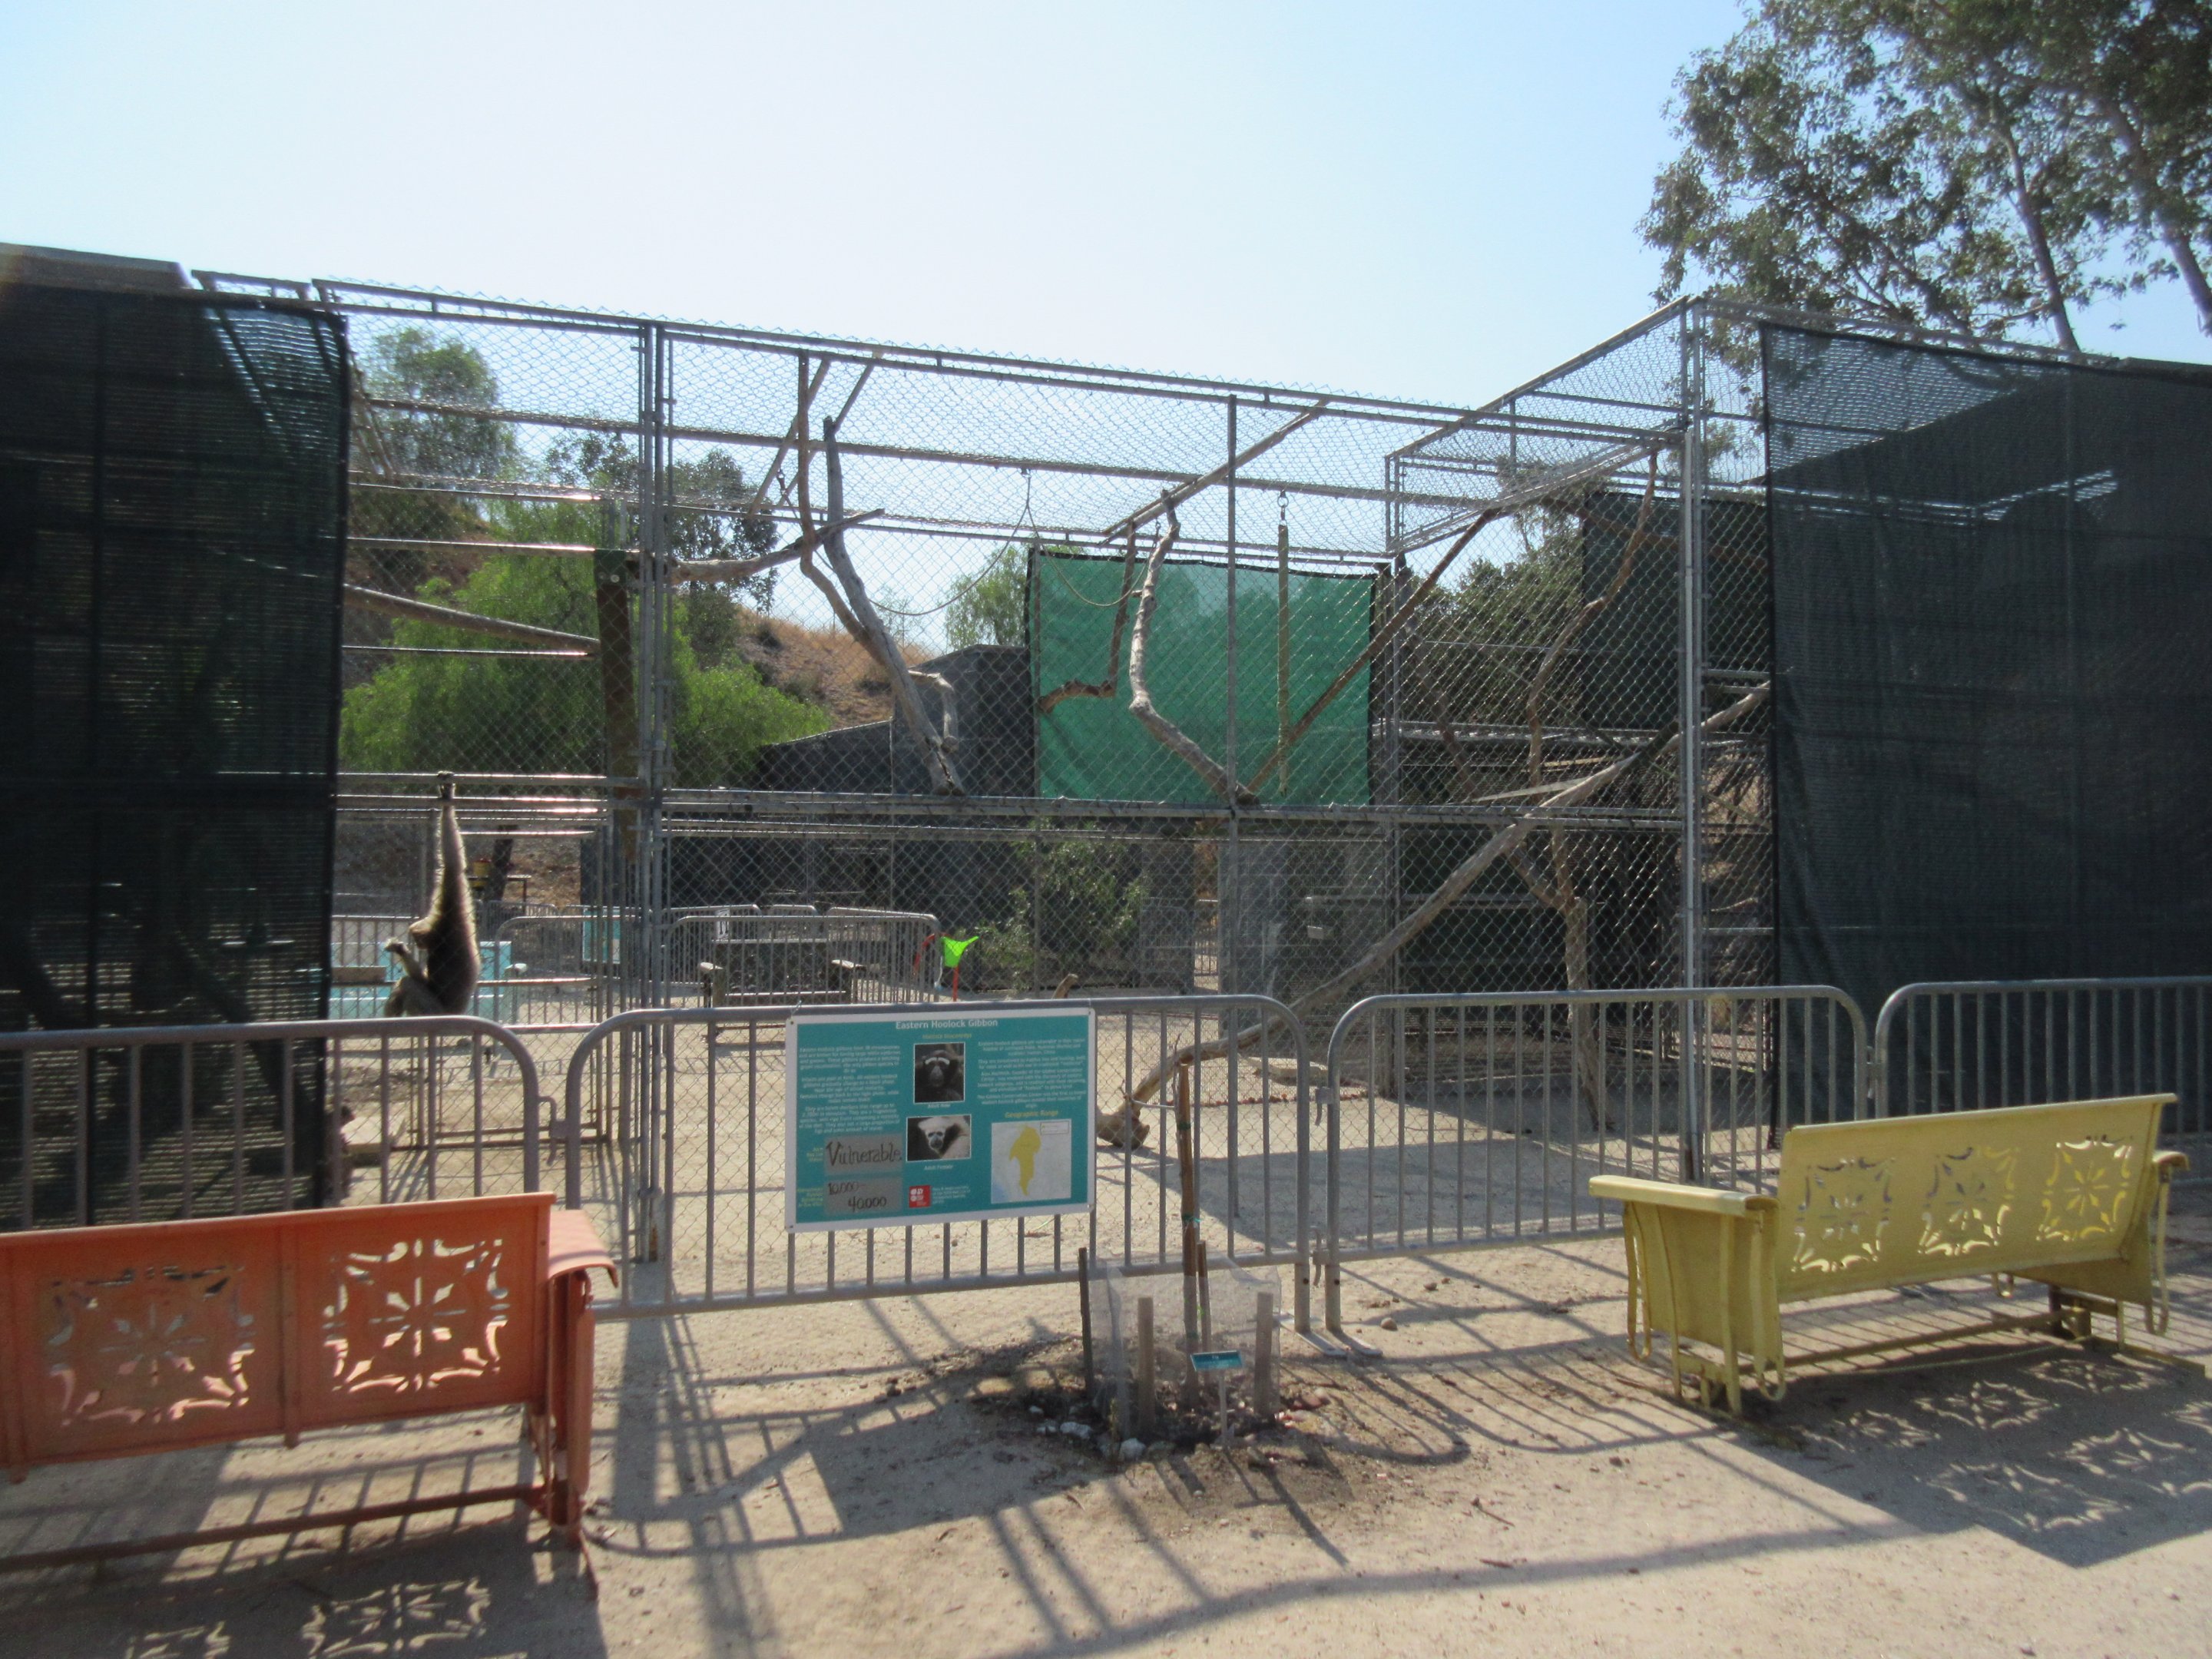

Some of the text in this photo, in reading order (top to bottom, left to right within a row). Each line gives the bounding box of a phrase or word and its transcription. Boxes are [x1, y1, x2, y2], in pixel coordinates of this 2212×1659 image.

[896, 1018, 998, 1030] Eastern Hoolock Gibbon
